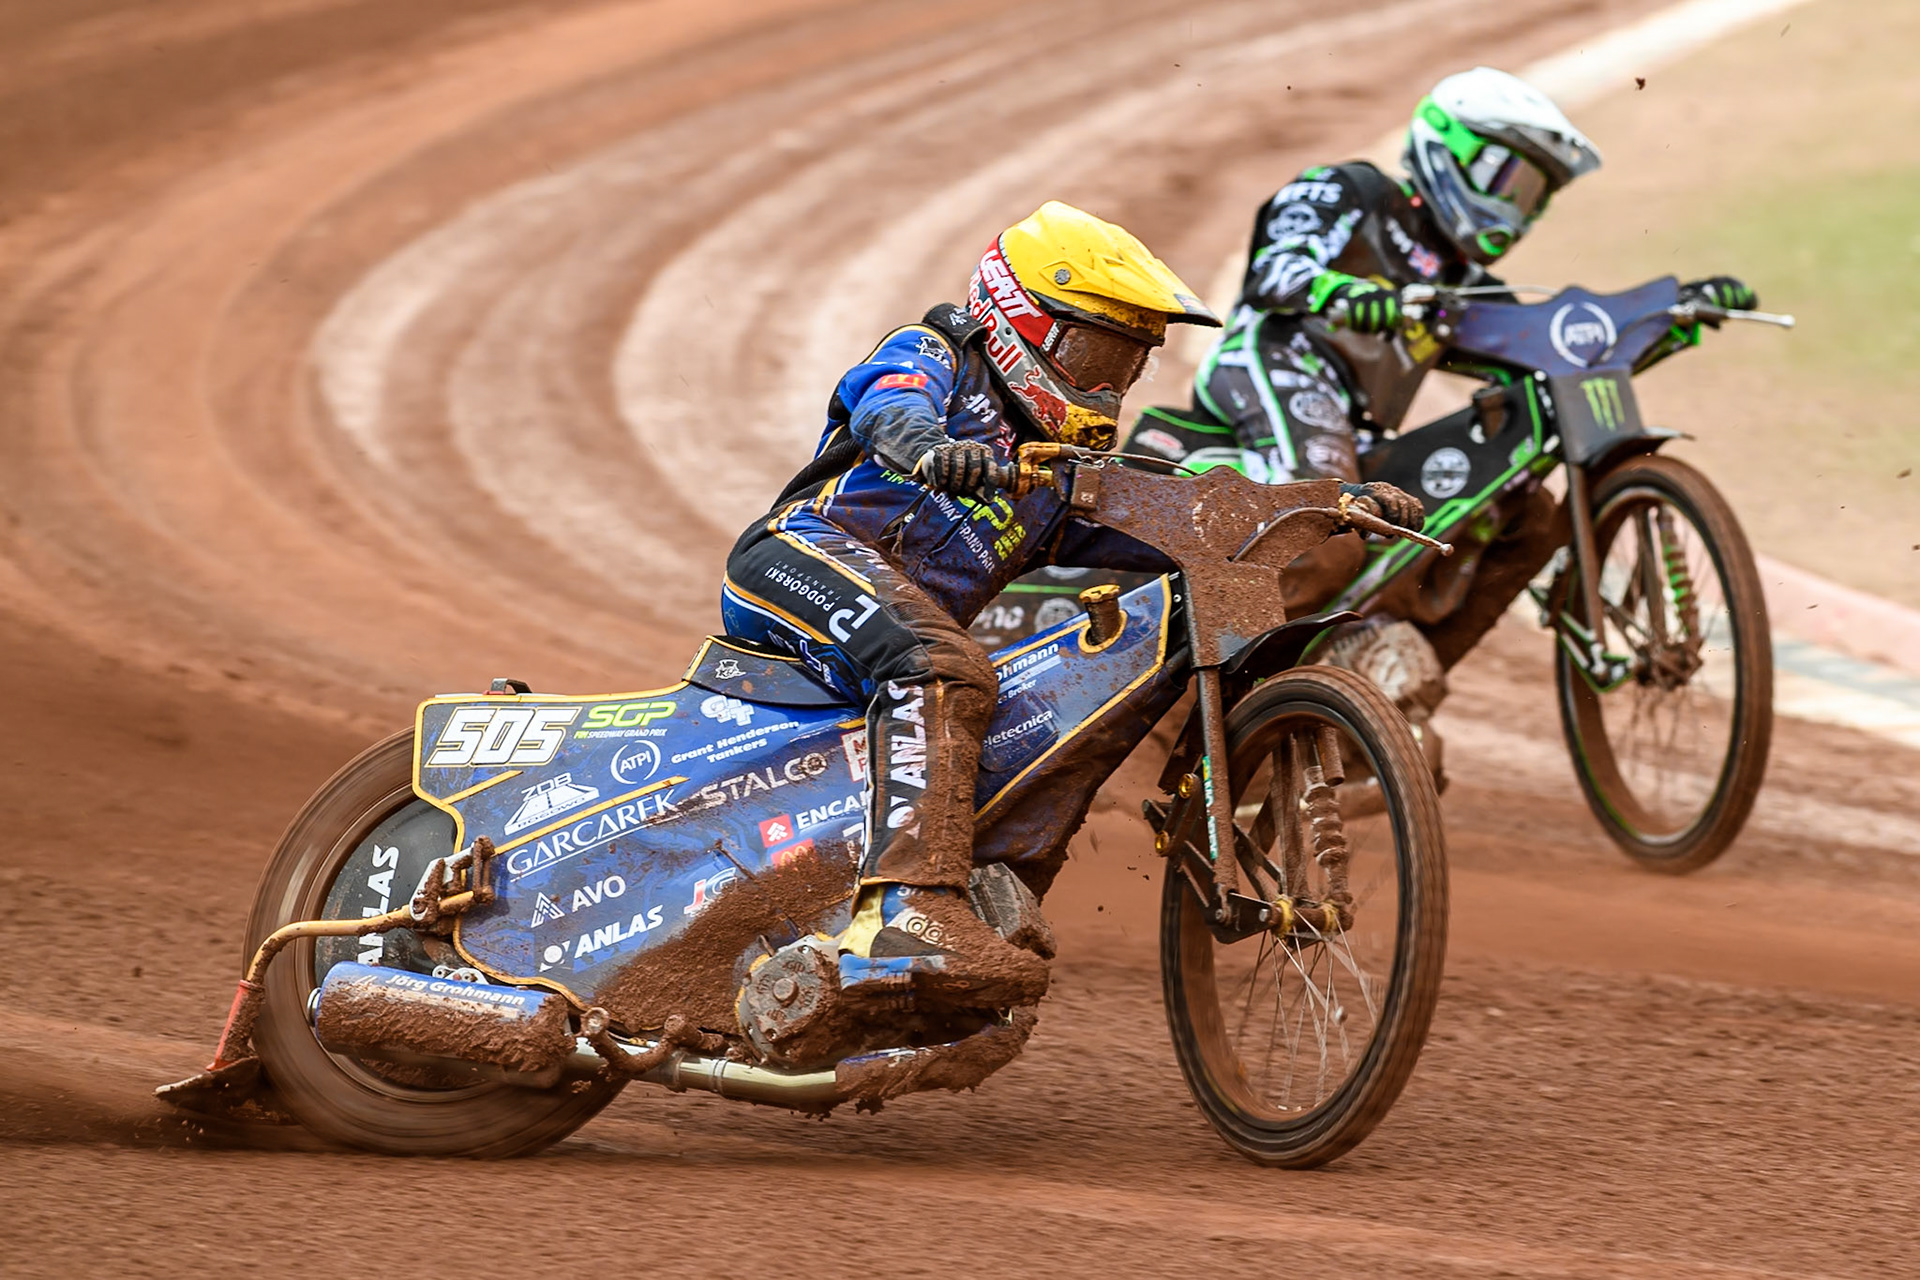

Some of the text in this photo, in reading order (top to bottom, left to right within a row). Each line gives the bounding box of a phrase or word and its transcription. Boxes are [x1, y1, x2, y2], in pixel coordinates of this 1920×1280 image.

[764, 566, 836, 611] PODGÓRSKI
[581, 701, 677, 729] SGP
[587, 729, 625, 739] SPEEDWAY
[624, 728, 649, 738] GRAND
[648, 728, 668, 737] PRIX
[888, 680, 927, 789] ANLAS
[425, 706, 582, 767] 505
[671, 721, 799, 765] Grant Henderson
[707, 738, 767, 763] Tankers
[620, 750, 652, 774] ATPI
[699, 752, 828, 807] STALCO
[572, 875, 626, 913] AVO
[574, 905, 664, 958] ANLAS
[385, 974, 526, 1006] Jörg Grohmann
